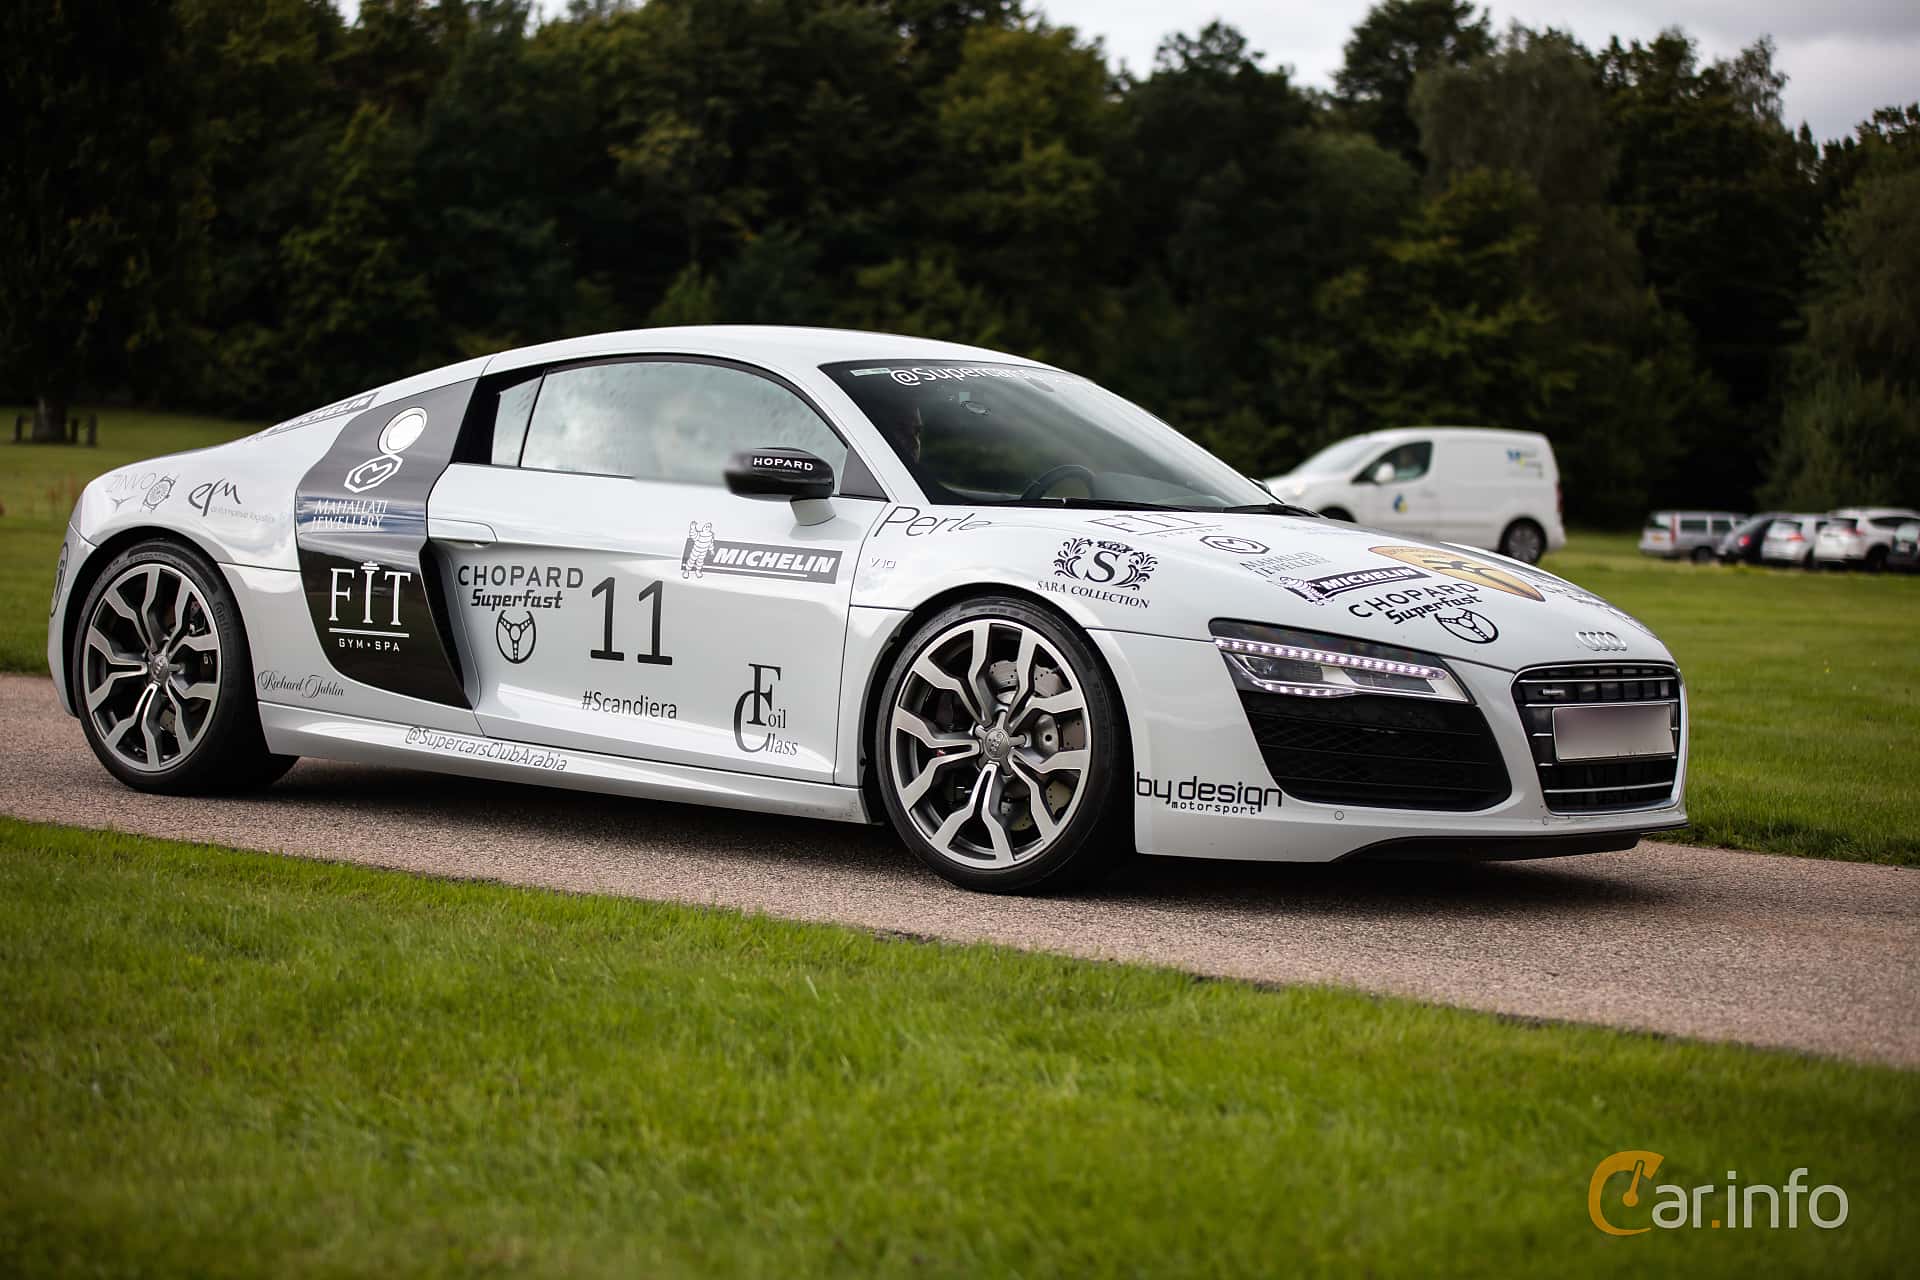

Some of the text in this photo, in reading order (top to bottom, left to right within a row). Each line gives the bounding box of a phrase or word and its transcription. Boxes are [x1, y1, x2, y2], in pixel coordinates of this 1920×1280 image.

[314, 500, 388, 514] MAHALLATI
[311, 515, 385, 530] JEWELLERY
[713, 547, 836, 574] MICHELIN
[458, 565, 584, 588] CHOPARD
[1320, 567, 1416, 591] MICHELIN
[328, 566, 412, 626] FIT
[471, 589, 563, 611] Superfast
[1036, 580, 1151, 609] SARA COLLECTION
[1348, 583, 1479, 618] CHOPARD
[590, 577, 673, 665] 11
[1385, 593, 1483, 624] Superfast
[257, 670, 304, 691] Richard
[581, 690, 678, 720] #Scandiera
[404, 726, 568, 772] @SupercarsClubArabia
[1171, 801, 1256, 815] motorsport
